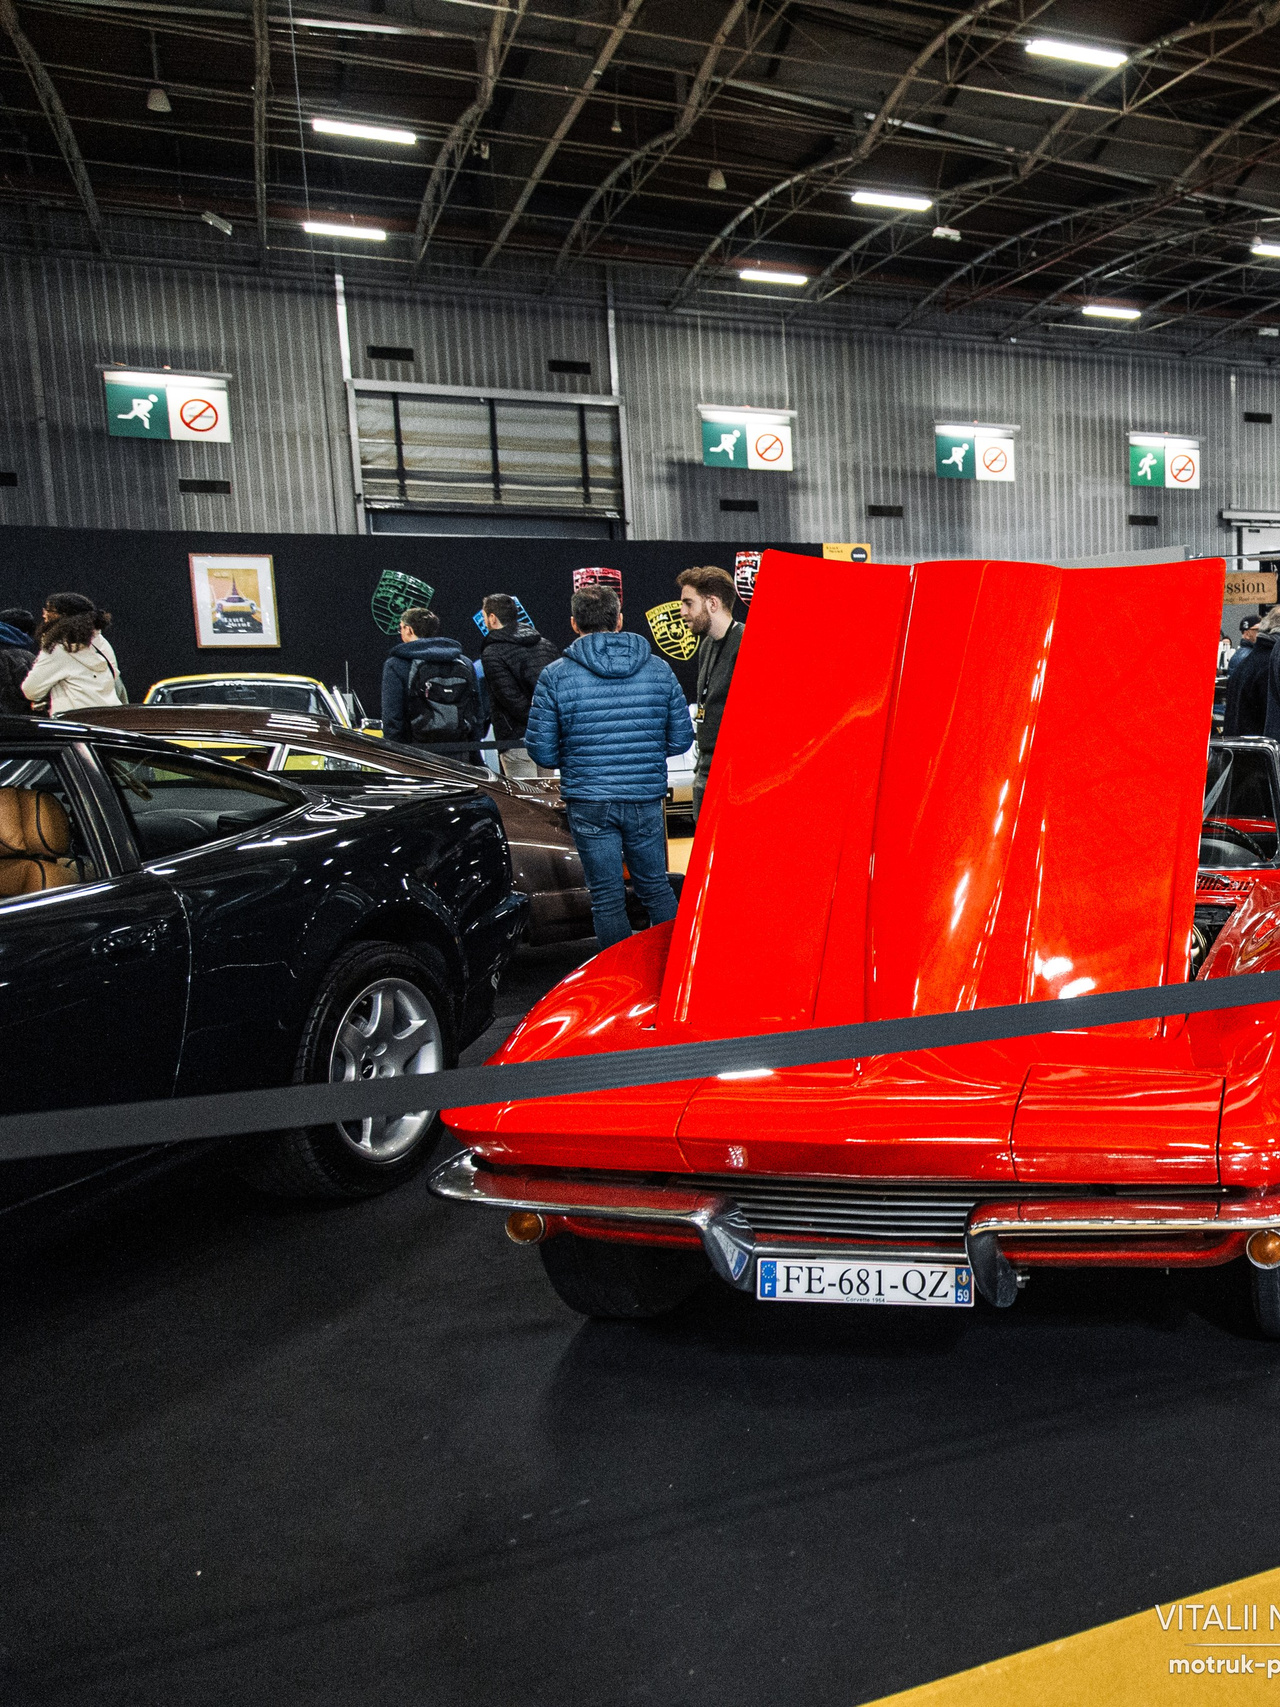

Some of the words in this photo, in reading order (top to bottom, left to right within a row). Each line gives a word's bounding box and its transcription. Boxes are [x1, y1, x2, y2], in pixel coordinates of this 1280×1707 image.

[1224, 579, 1266, 595] ssion
[764, 1282, 773, 1295] F
[782, 1265, 949, 1301] FE-681-QZ
[956, 1289, 970, 1302] 59
